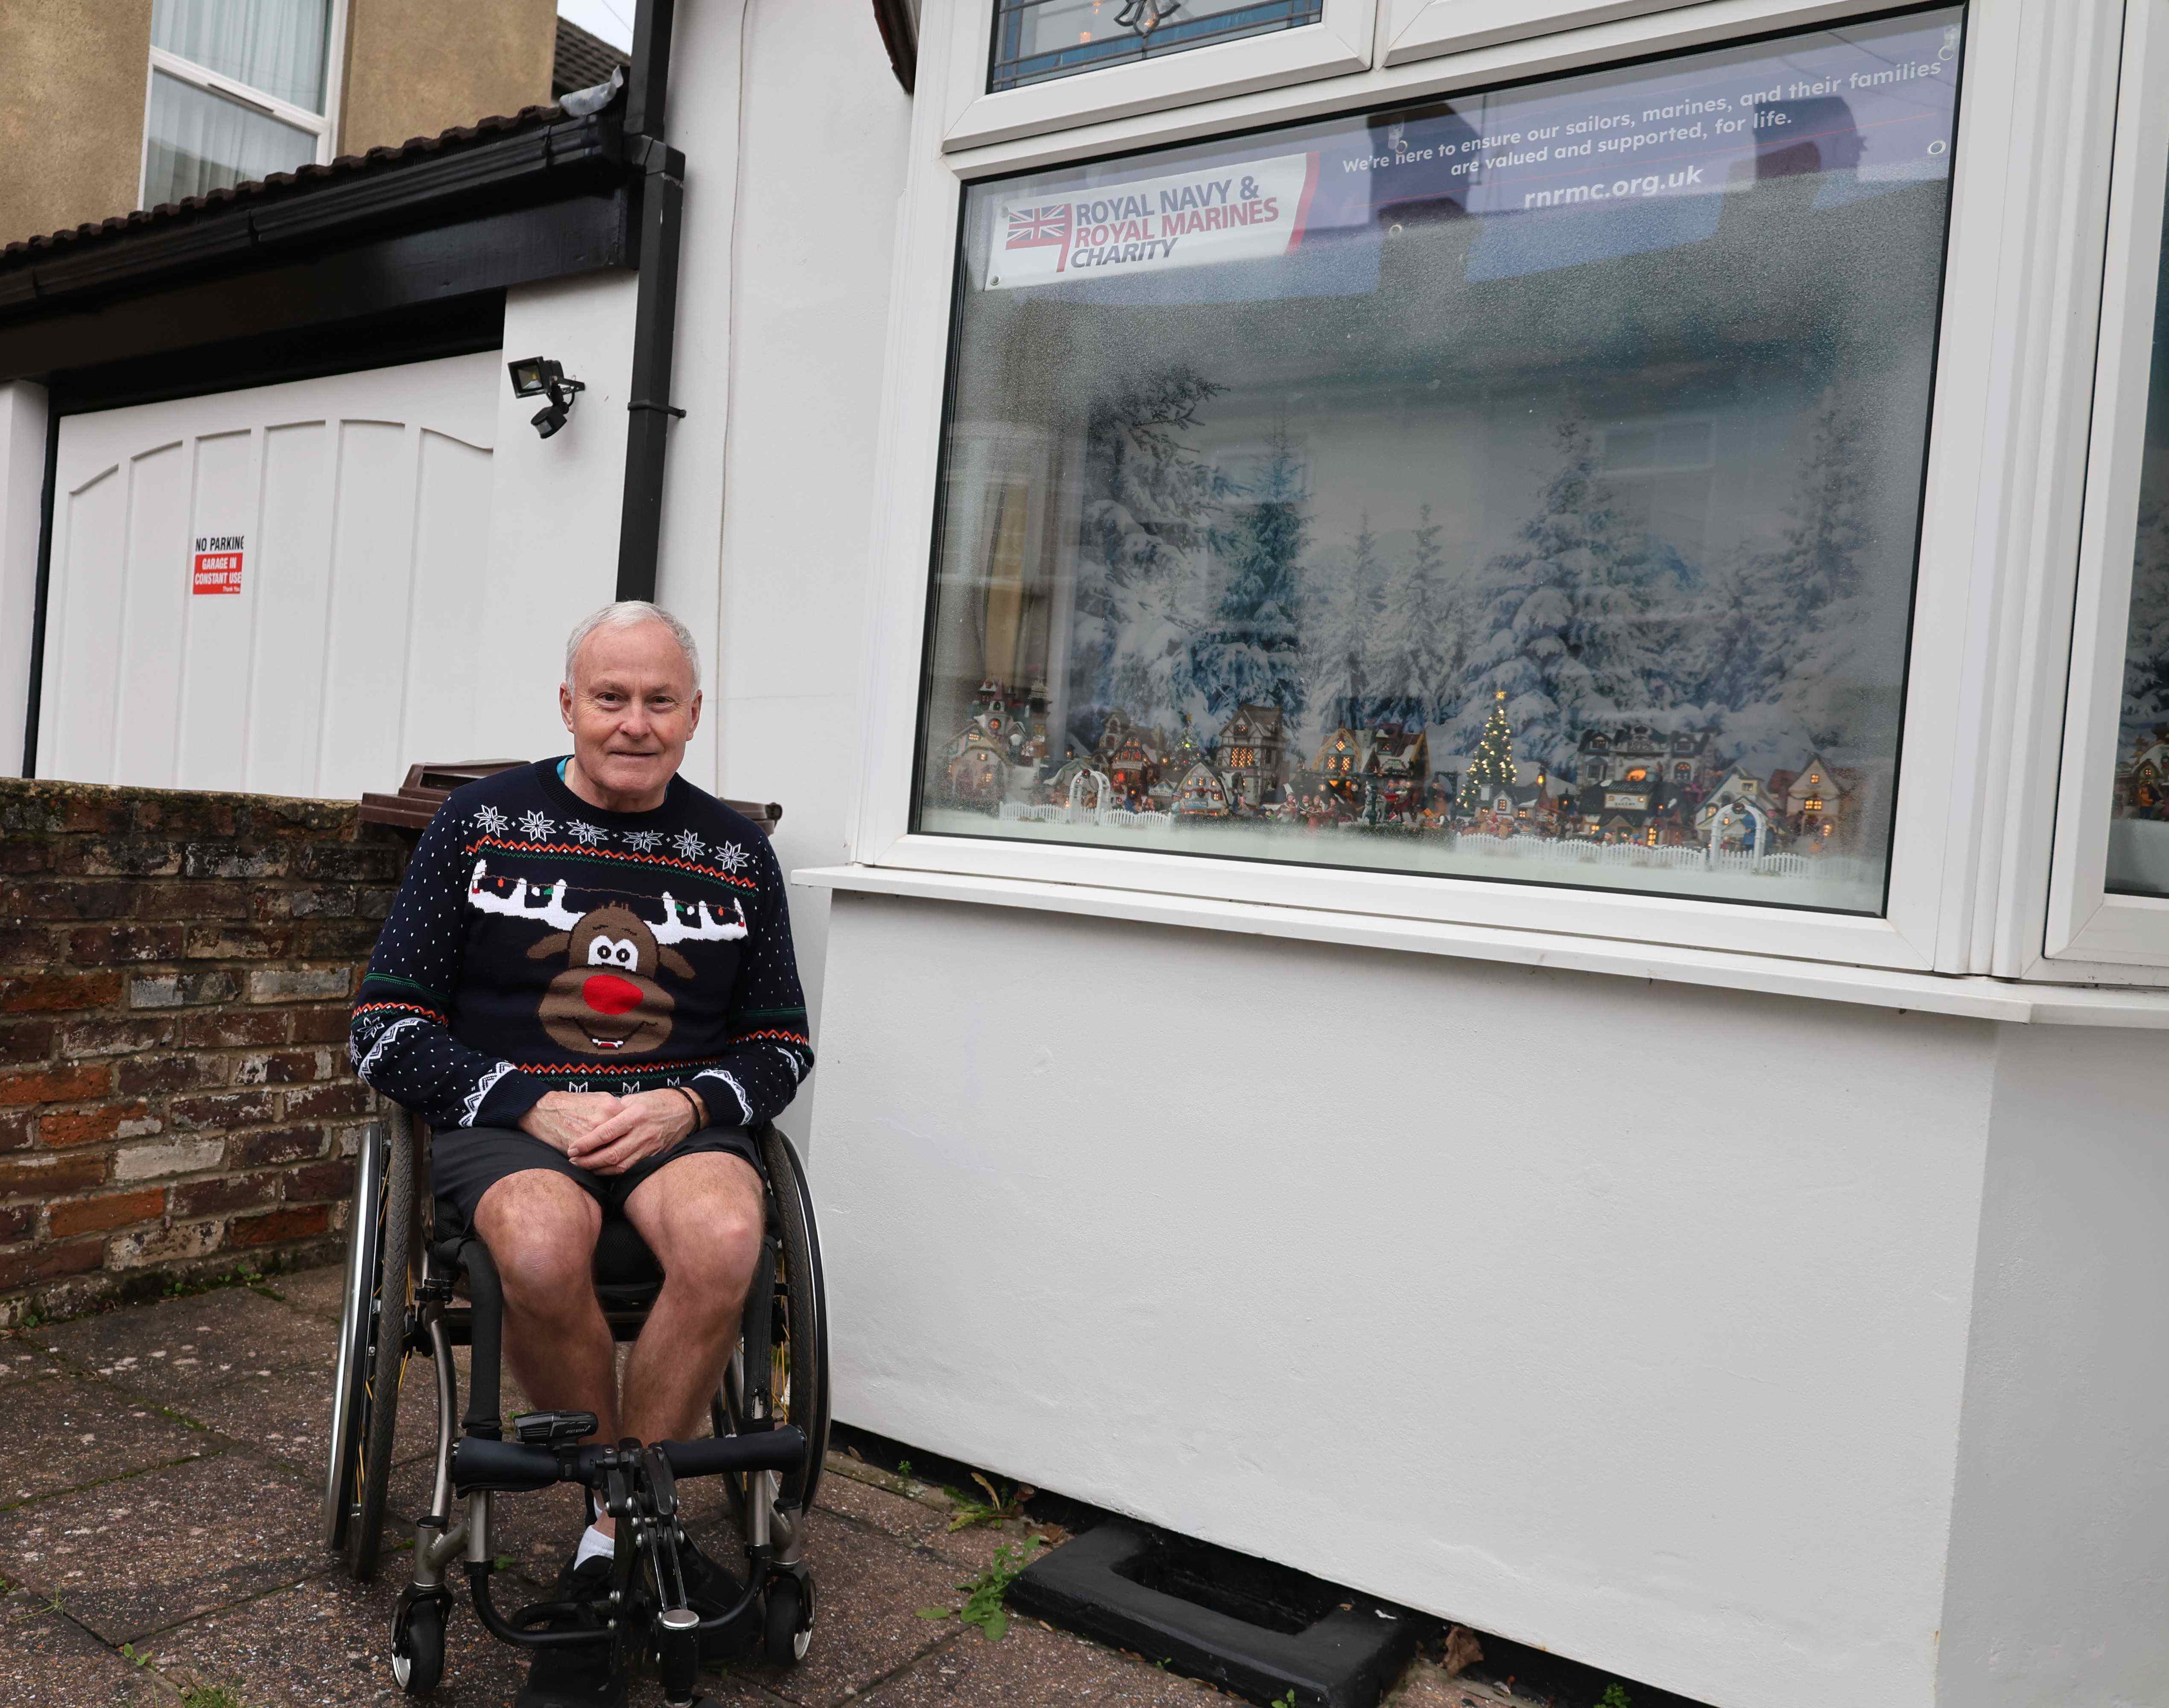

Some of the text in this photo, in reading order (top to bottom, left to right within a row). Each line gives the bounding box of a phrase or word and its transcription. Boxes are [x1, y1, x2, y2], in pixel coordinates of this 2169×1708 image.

[1438, 143, 1456, 157] to
[1461, 131, 1521, 153] ensure
[1527, 125, 1560, 141] our
[1566, 113, 1635, 135] sailors,
[1642, 99, 1733, 123] marines,
[1739, 85, 1781, 107] and
[1789, 76, 1842, 99] their
[1849, 61, 1942, 89] families
[1450, 110, 1792, 176] are valued and supported, for life.
[1076, 175, 1260, 226] ROYAL NAVY &
[1524, 165, 1704, 209] rnrmc.org.uk
[1074, 196, 1279, 249] ROYAL MARINES
[1070, 237, 1179, 268] CHARITY
[196, 538, 207, 552] NO
[202, 556, 237, 570] GARAGE IN
[195, 571, 241, 585] CONSTANT USE
